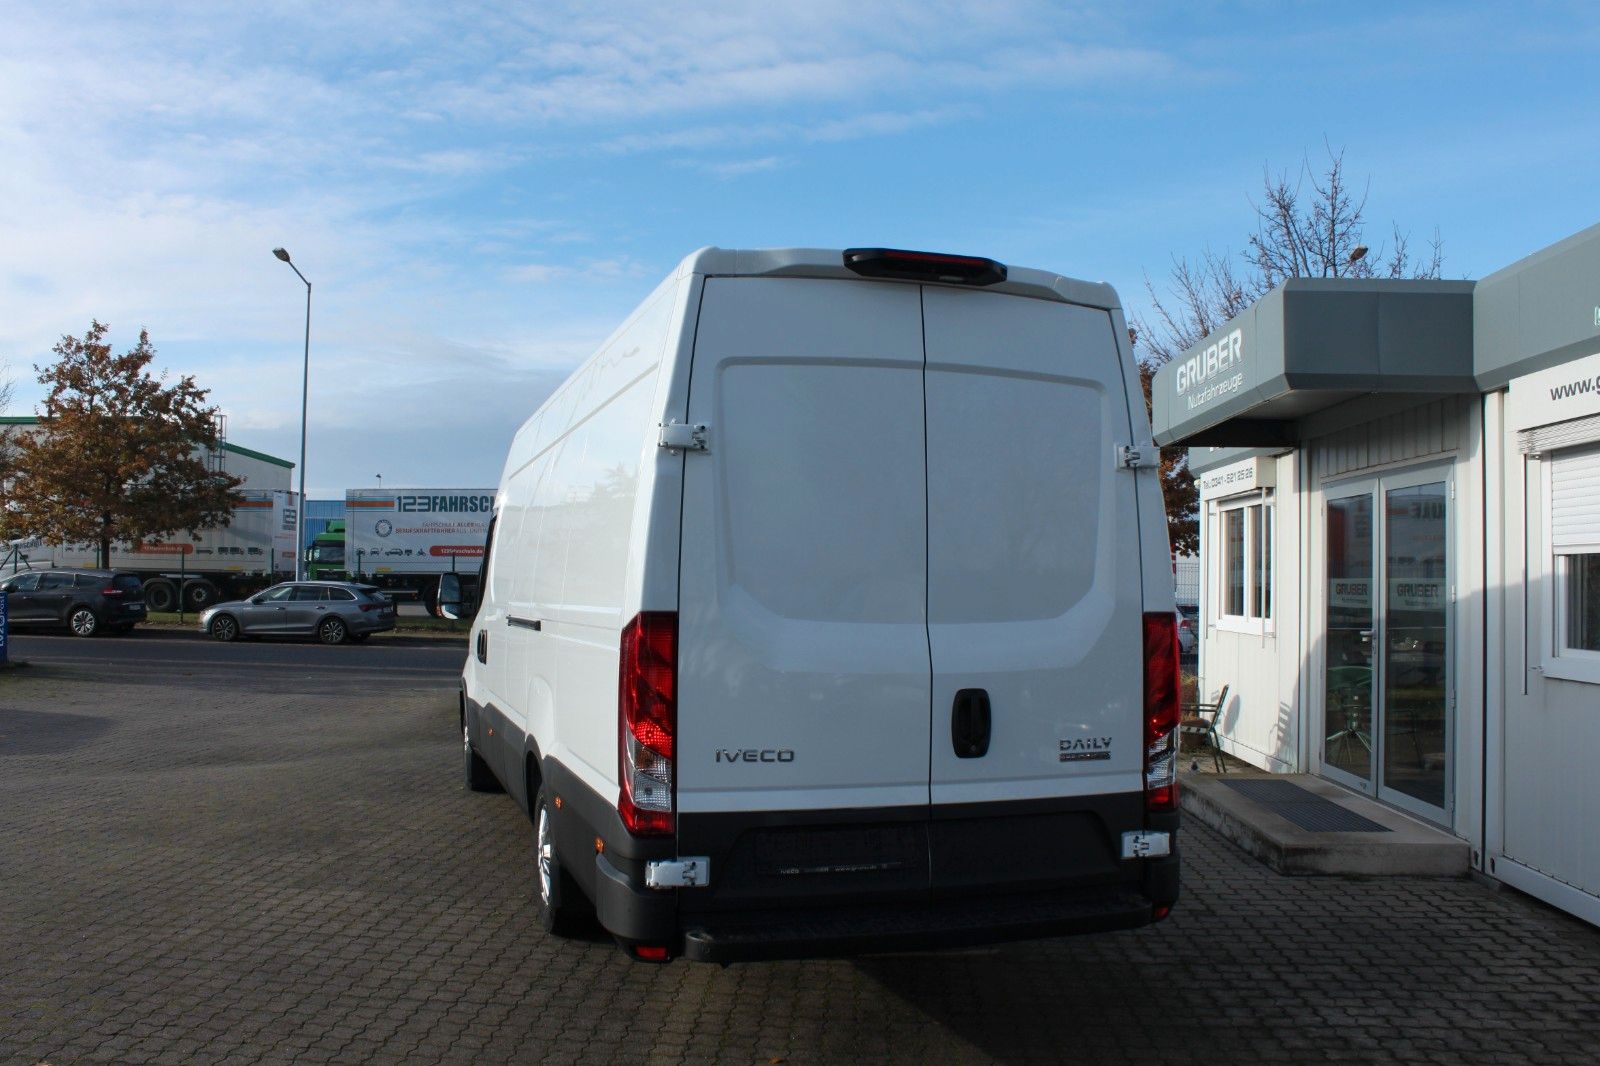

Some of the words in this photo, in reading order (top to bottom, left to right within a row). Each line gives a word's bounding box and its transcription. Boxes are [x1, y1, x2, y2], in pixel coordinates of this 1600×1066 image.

[1176, 328, 1242, 396] GRUBER
[1188, 373, 1244, 410] Nutzfahrzeuge
[1335, 583, 1368, 596] GRUBER
[1397, 583, 1438, 598] GRUBER
[1060, 737, 1112, 751] DAILY
[715, 749, 795, 763] IVECO
